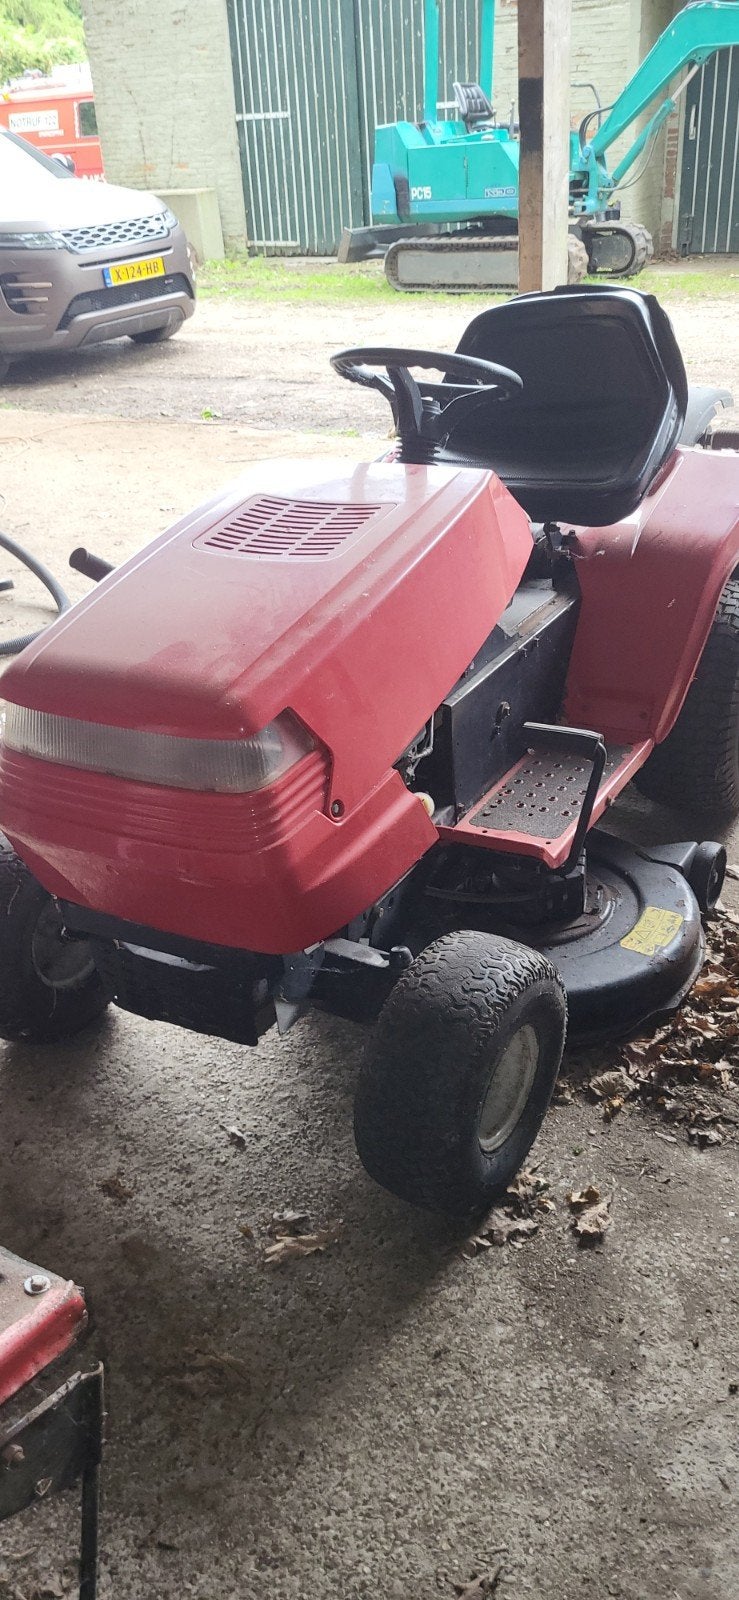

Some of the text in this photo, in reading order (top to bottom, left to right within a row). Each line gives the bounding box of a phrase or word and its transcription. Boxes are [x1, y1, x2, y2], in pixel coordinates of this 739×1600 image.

[11, 115, 41, 128] NOTRUF
[411, 186, 432, 200] PC15
[115, 261, 160, 281] X-124-HB
